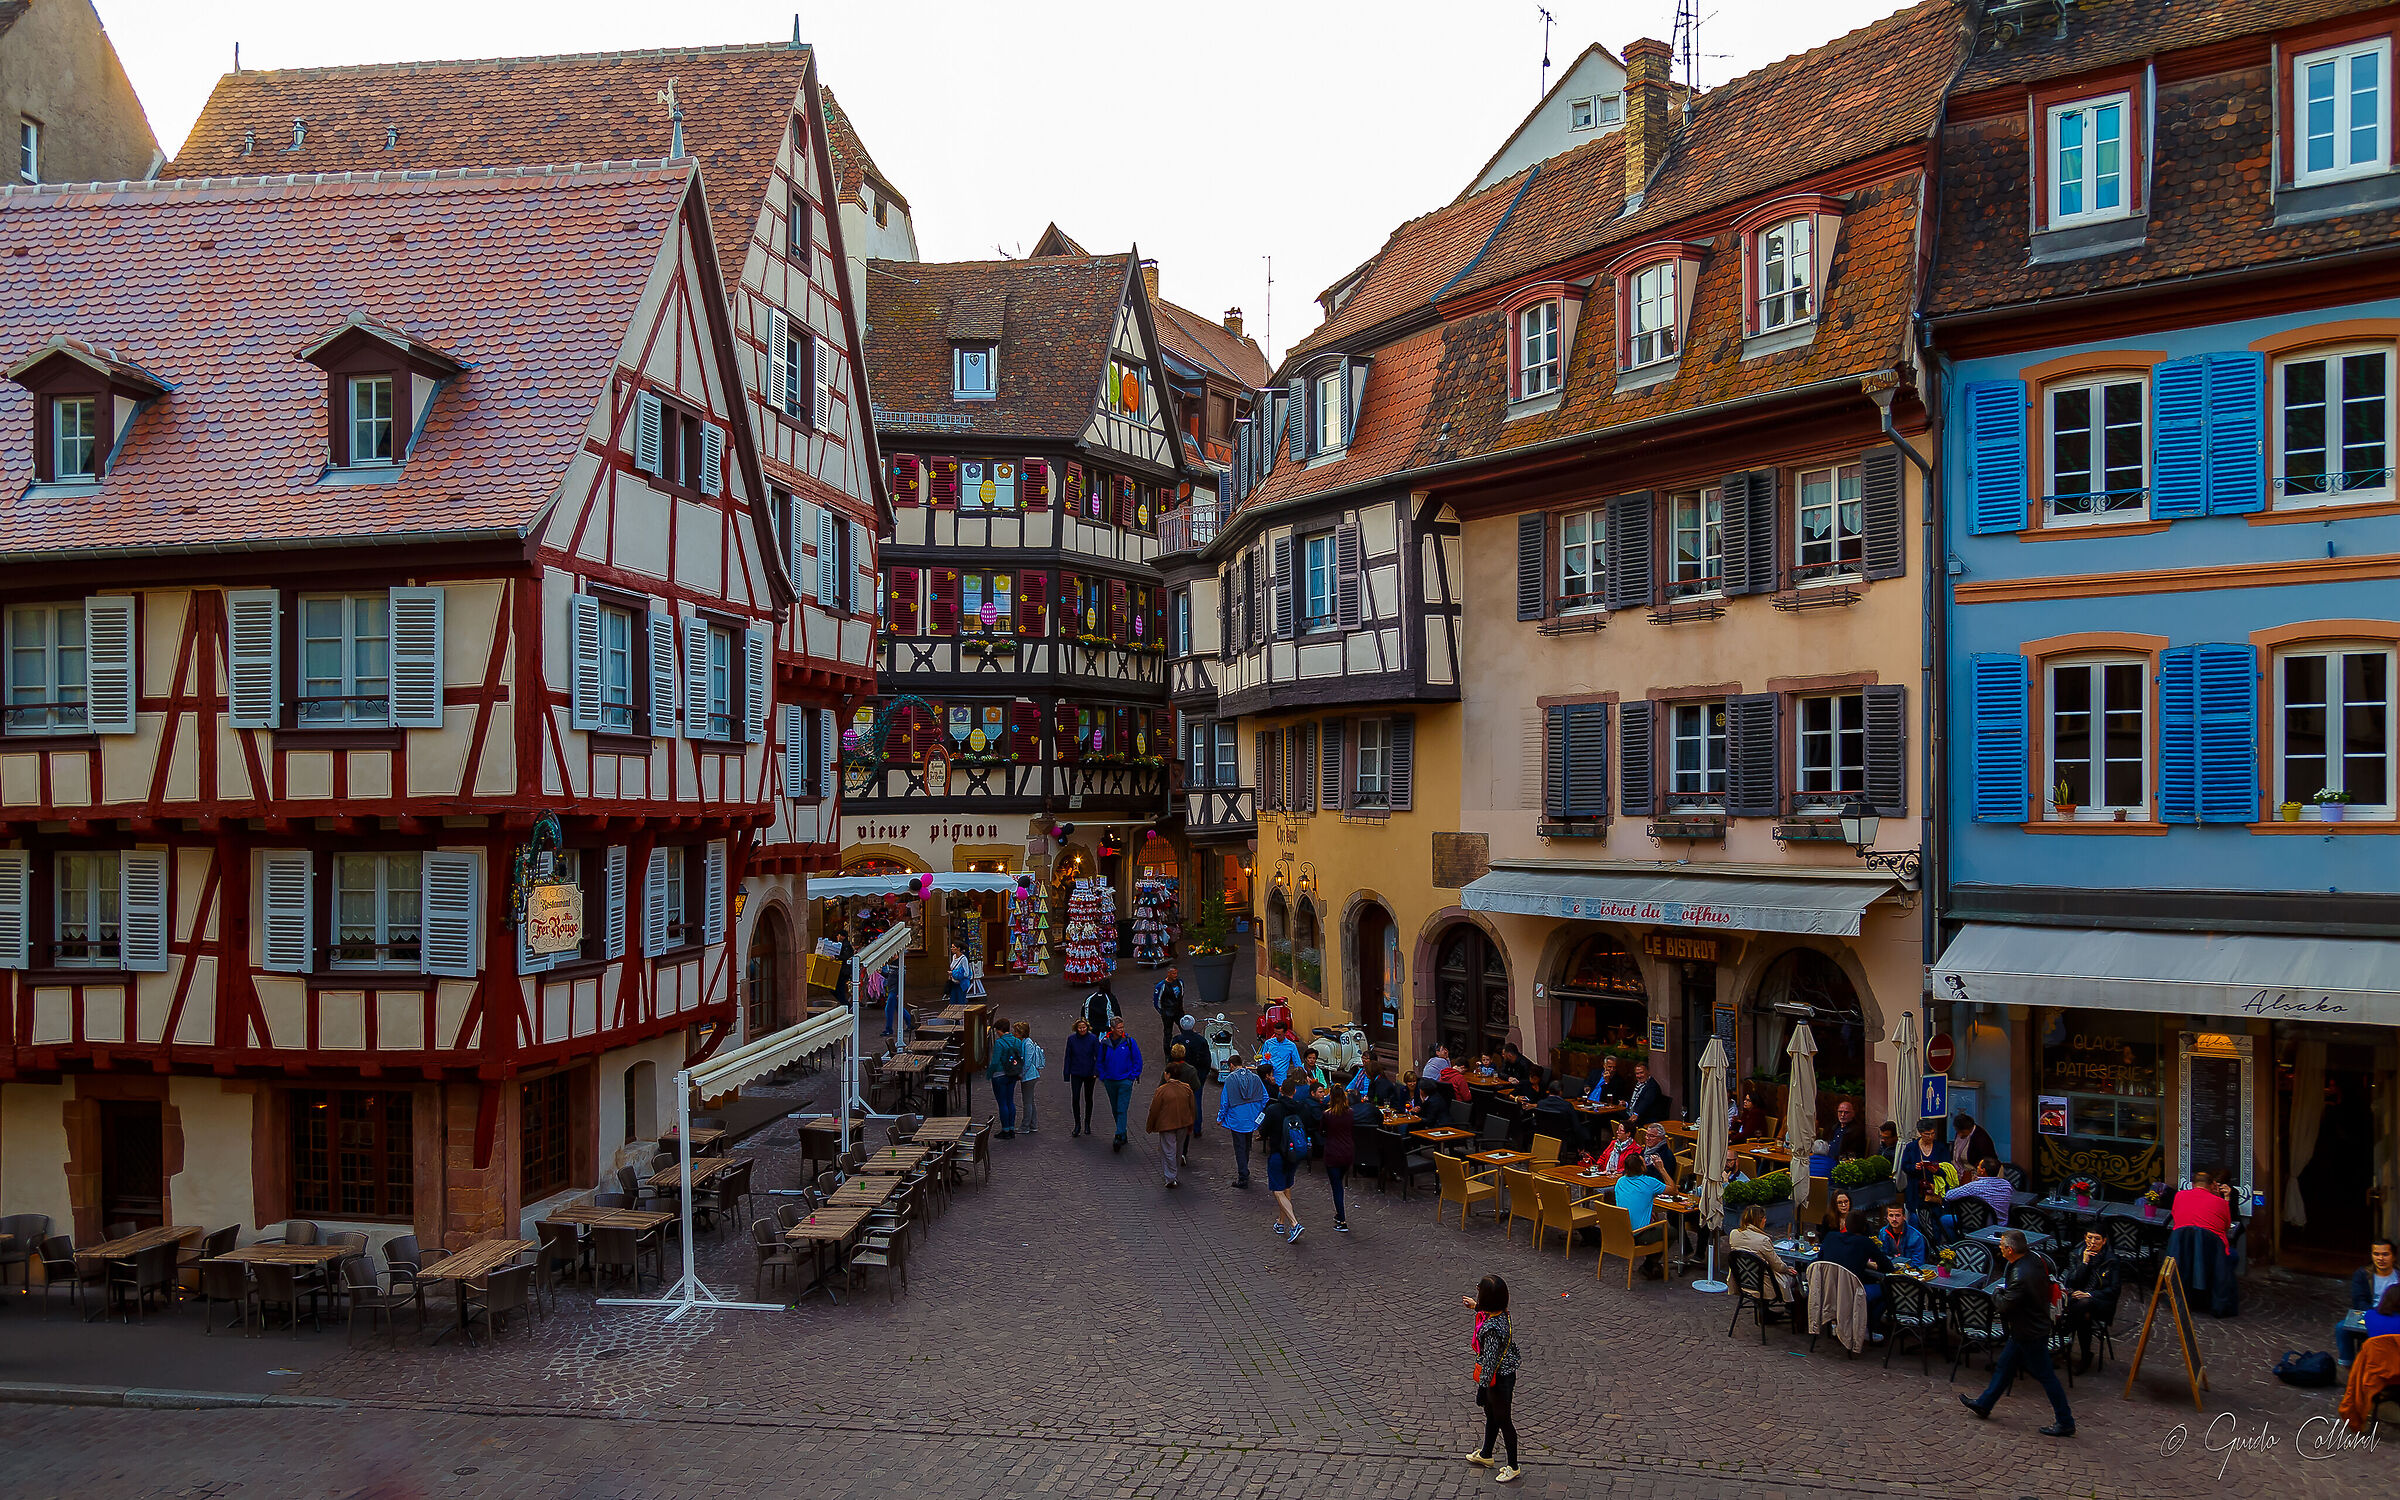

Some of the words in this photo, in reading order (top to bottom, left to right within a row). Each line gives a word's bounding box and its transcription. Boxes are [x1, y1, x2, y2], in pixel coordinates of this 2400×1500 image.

[857, 819, 911, 839] vieux
[929, 818, 999, 845] pignon
[1640, 903, 1661, 918] du
[530, 918, 550, 941] Fer
[549, 915, 579, 939] Rouge
[1644, 935, 1662, 955] LE
[1666, 937, 1716, 960] BISTROT
[2241, 989, 2348, 1015] Alsako
[1340, 1035, 1350, 1046] 59
[2073, 1033, 2124, 1053] GLACE
[2056, 1060, 2142, 1082] PATISSERIE
